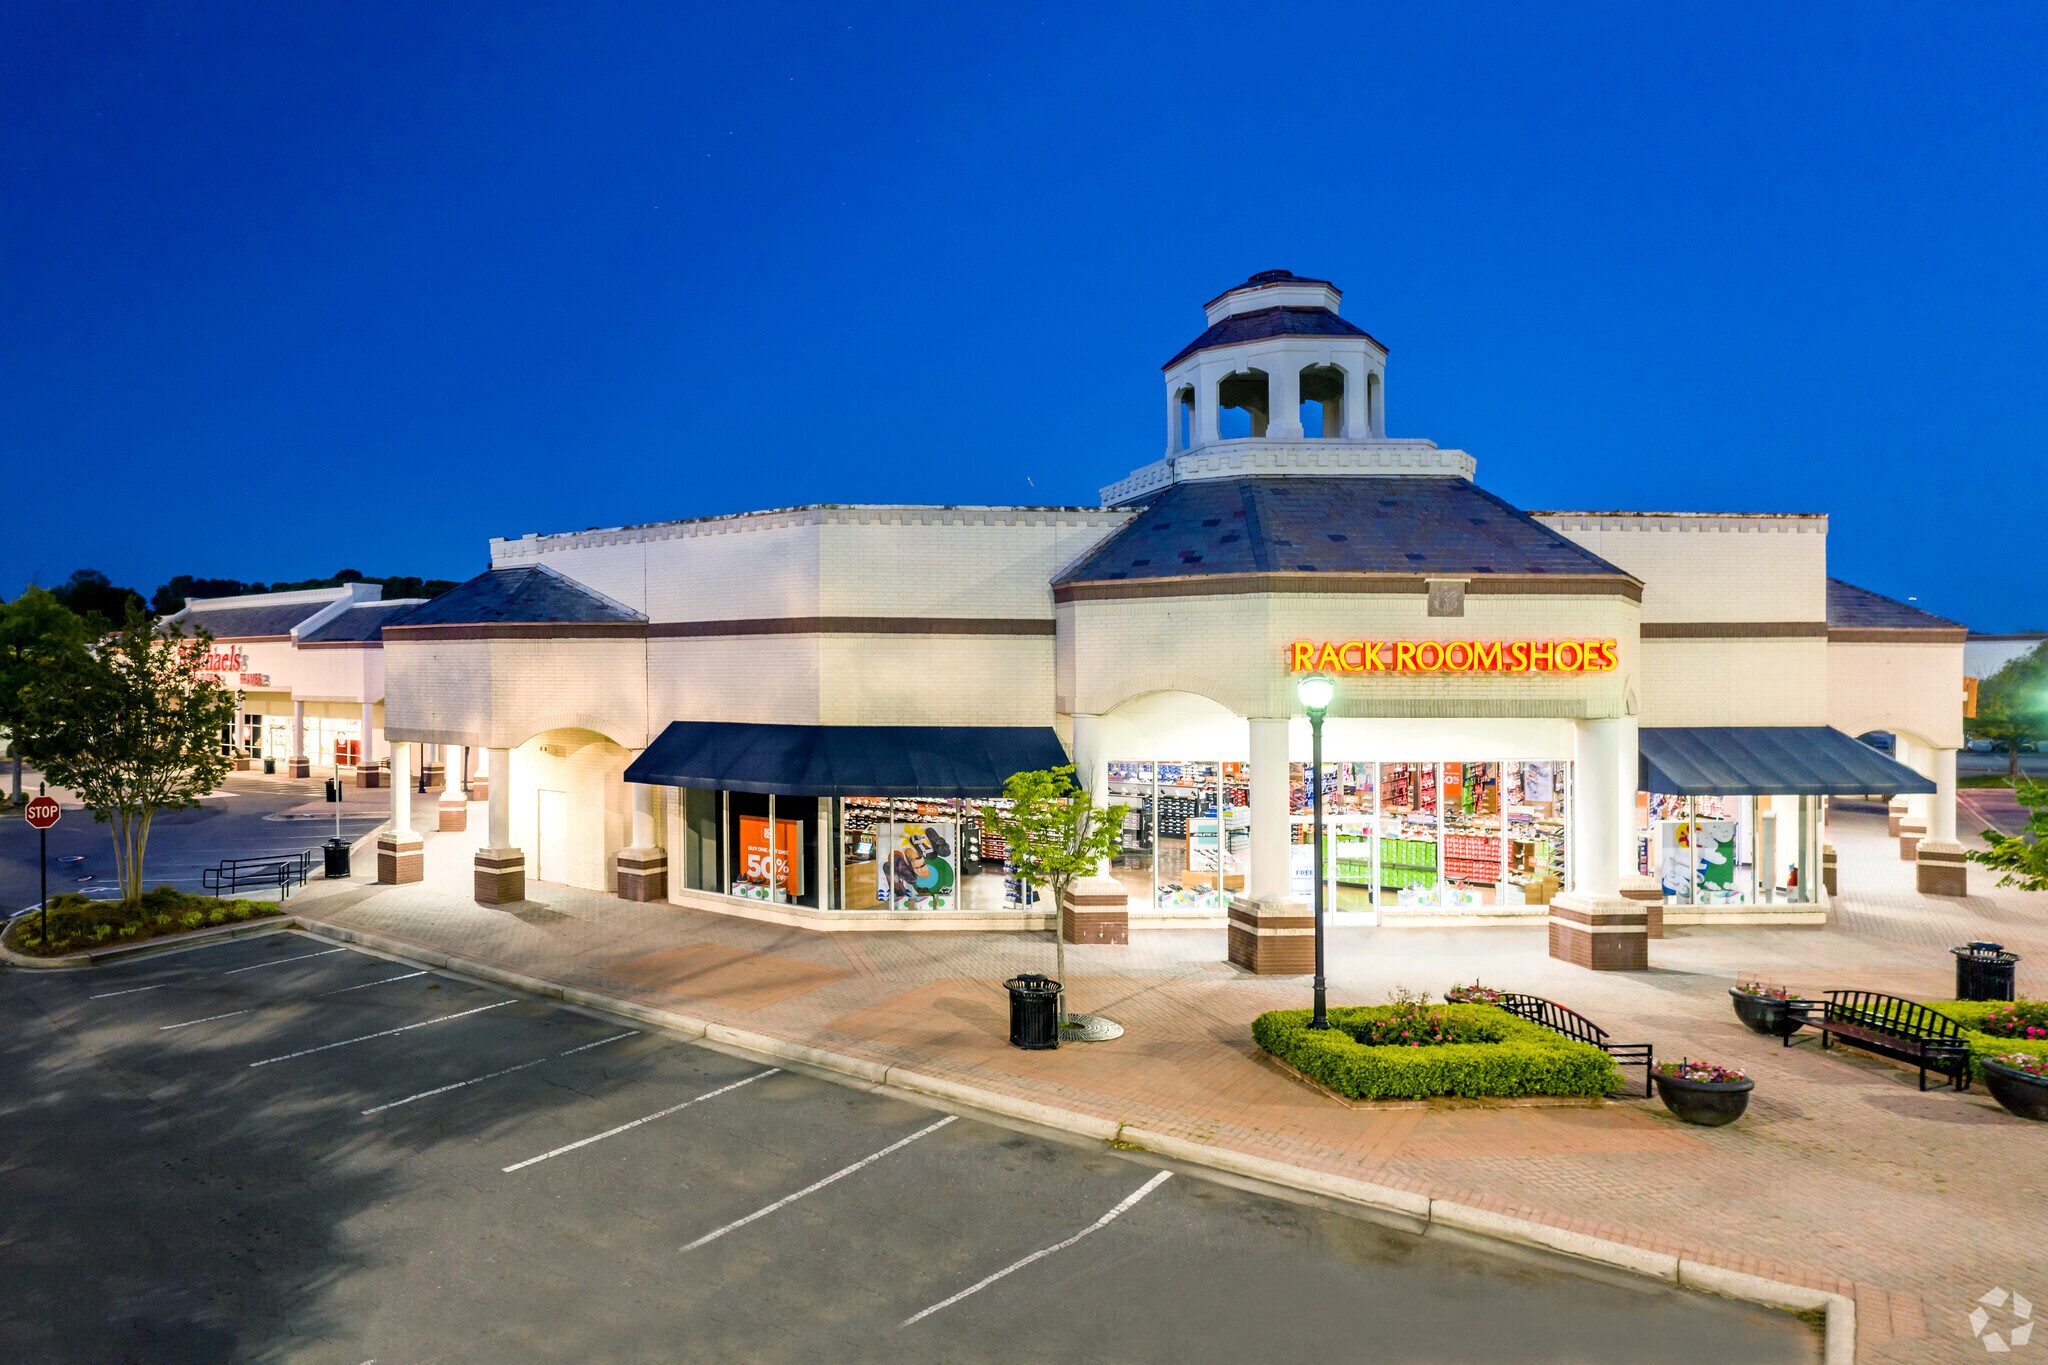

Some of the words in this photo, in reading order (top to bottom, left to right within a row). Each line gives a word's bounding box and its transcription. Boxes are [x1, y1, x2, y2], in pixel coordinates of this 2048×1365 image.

[1291, 640, 1386, 672] RACK
[1394, 640, 1504, 672] ROOM
[1510, 639, 1618, 671] SHOES
[28, 805, 58, 819] STOP
[747, 854, 789, 879] 50%
